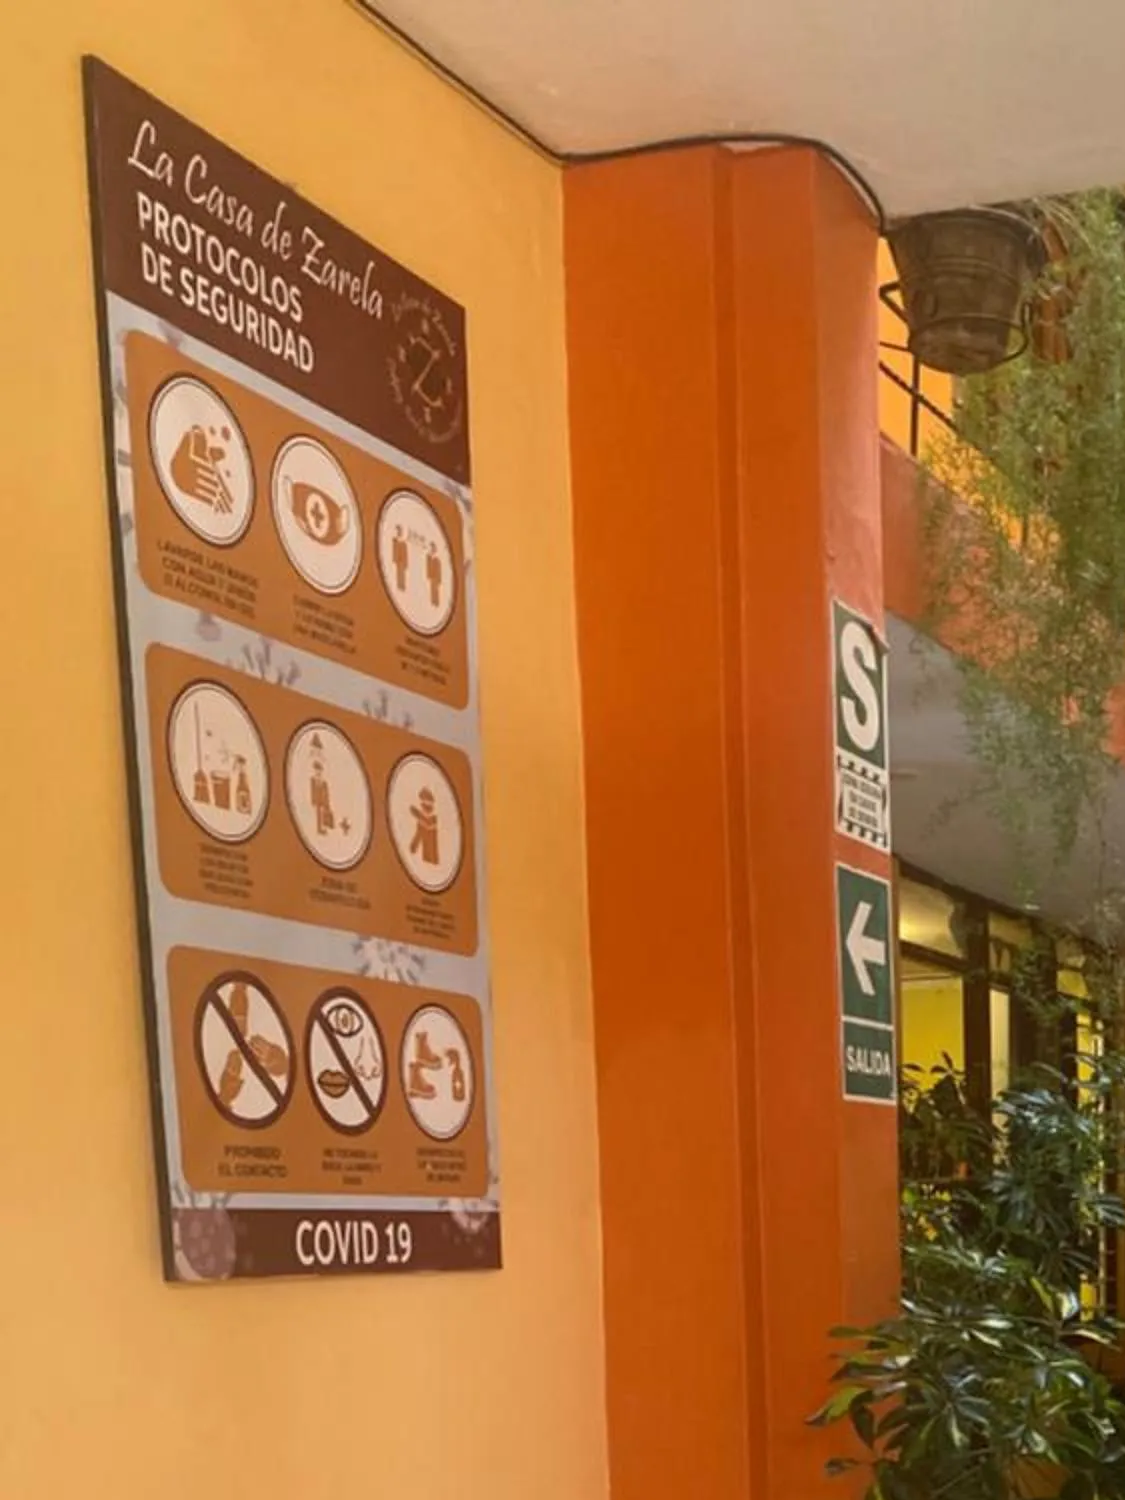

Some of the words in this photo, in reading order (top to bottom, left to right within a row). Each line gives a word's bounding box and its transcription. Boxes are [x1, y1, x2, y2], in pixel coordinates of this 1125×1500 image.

[127, 120, 174, 187] La
[185, 155, 254, 237] Casa
[261, 201, 292, 260] de
[301, 226, 383, 319] Zarela
[137, 191, 303, 323] PROTOCOLOS
[142, 241, 173, 296] DE
[179, 268, 315, 374] SEGURIDAD
[840, 621, 880, 751] S
[846, 1046, 890, 1076] SALIDA
[295, 1220, 379, 1265] COVID
[385, 1222, 412, 1263] 19
